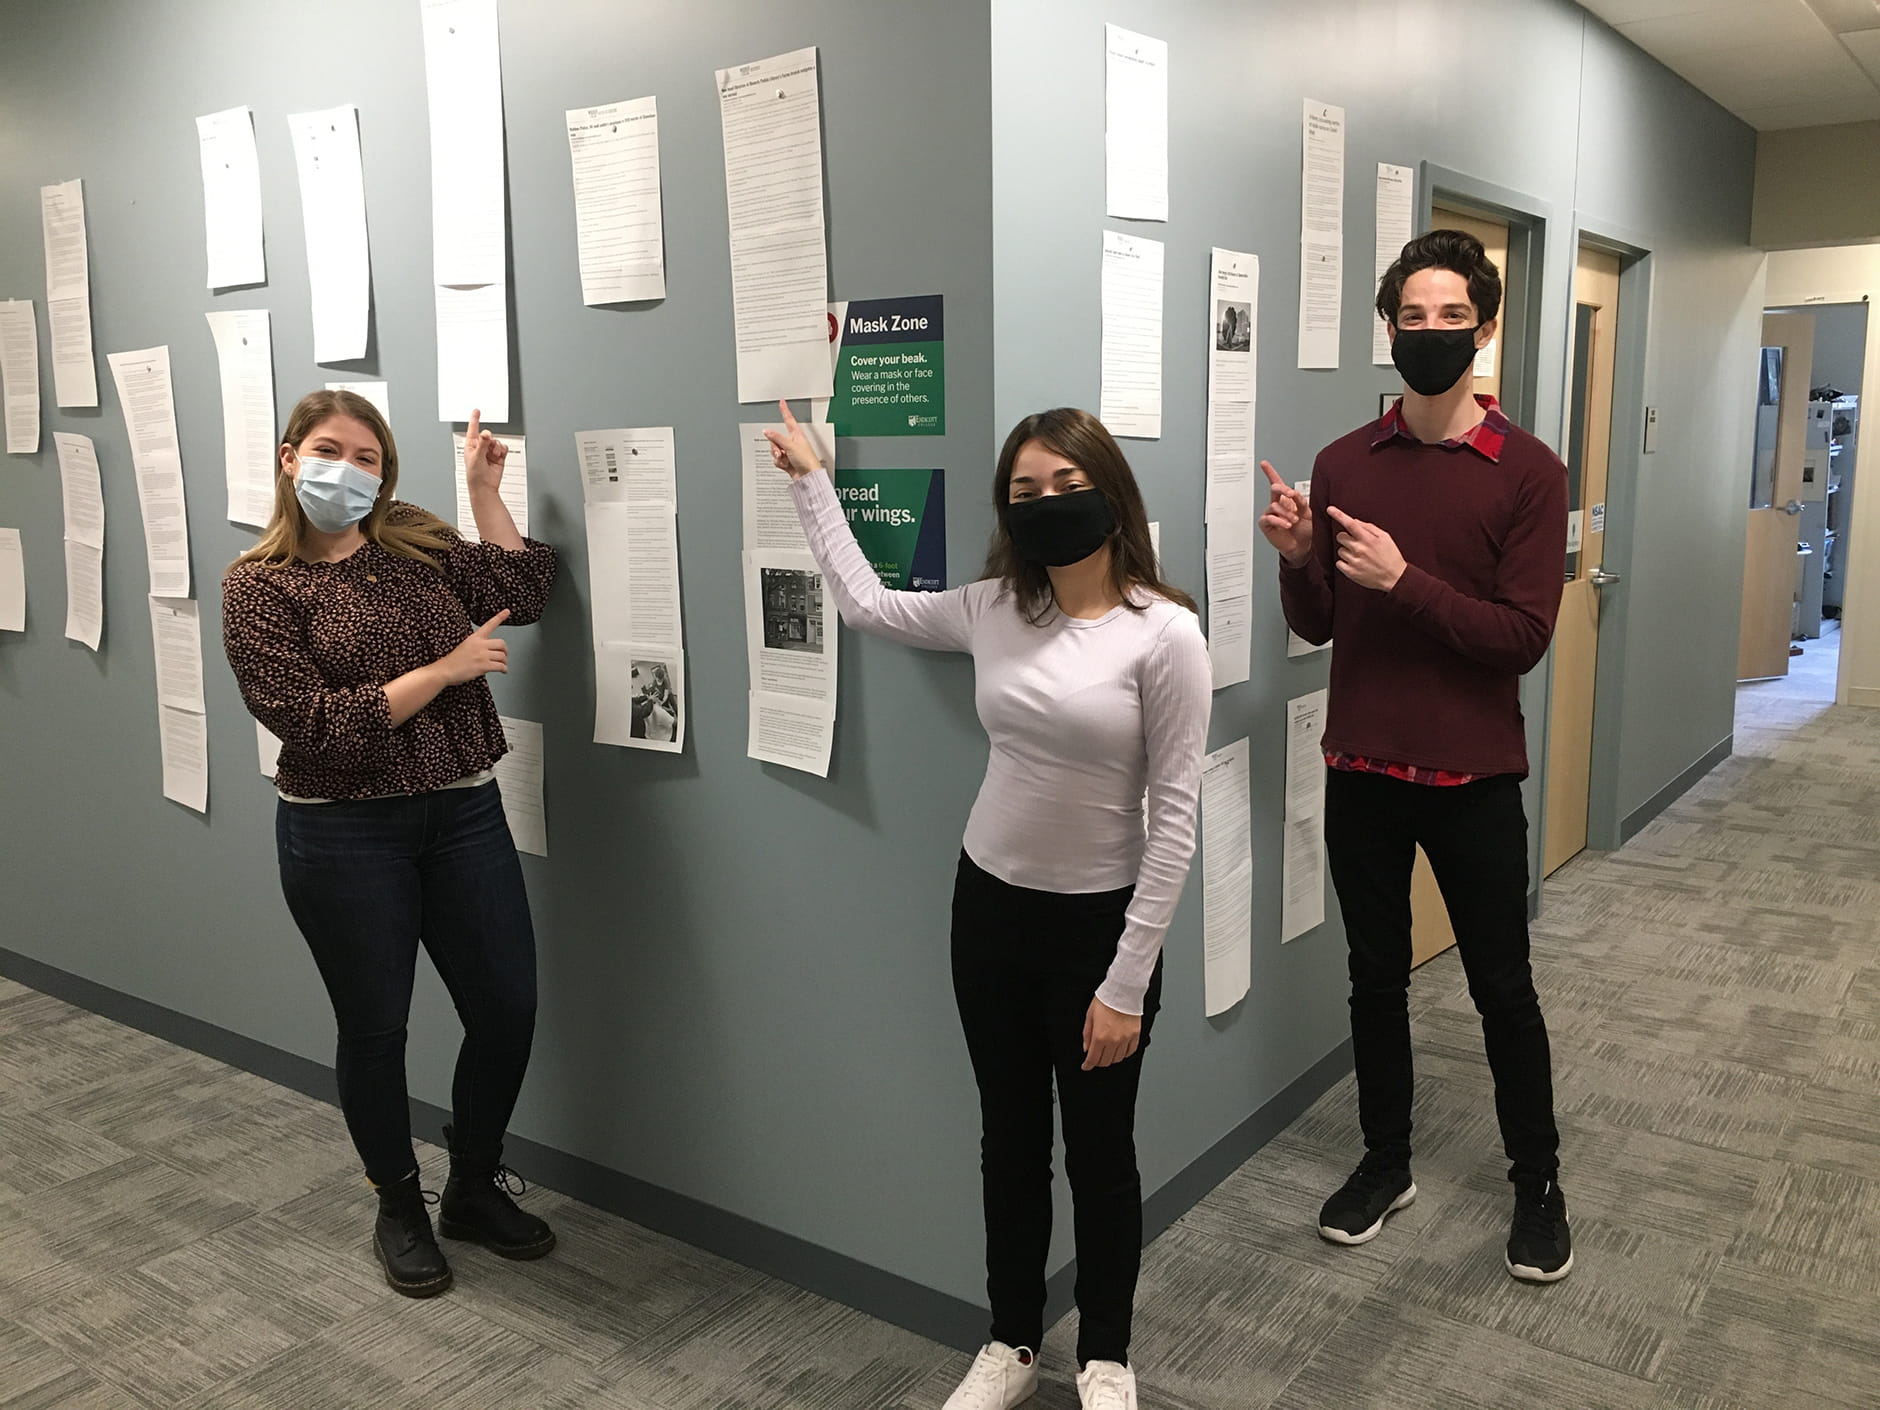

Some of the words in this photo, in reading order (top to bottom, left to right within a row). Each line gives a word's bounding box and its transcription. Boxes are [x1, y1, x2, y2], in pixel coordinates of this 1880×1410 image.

[850, 316, 888, 334] Mask
[891, 315, 928, 331] Zone
[851, 356, 878, 366] Cover
[879, 356, 900, 366] your
[902, 353, 928, 363] beak.
[852, 371, 872, 380] Wear
[880, 369, 902, 379] mask
[914, 368, 933, 378] face
[852, 382, 886, 393] covering
[887, 382, 894, 391] in
[896, 382, 910, 391] the
[852, 396, 888, 406] presence
[890, 394, 899, 403] of
[900, 394, 929, 403] others.
[861, 504, 916, 526] wings.
